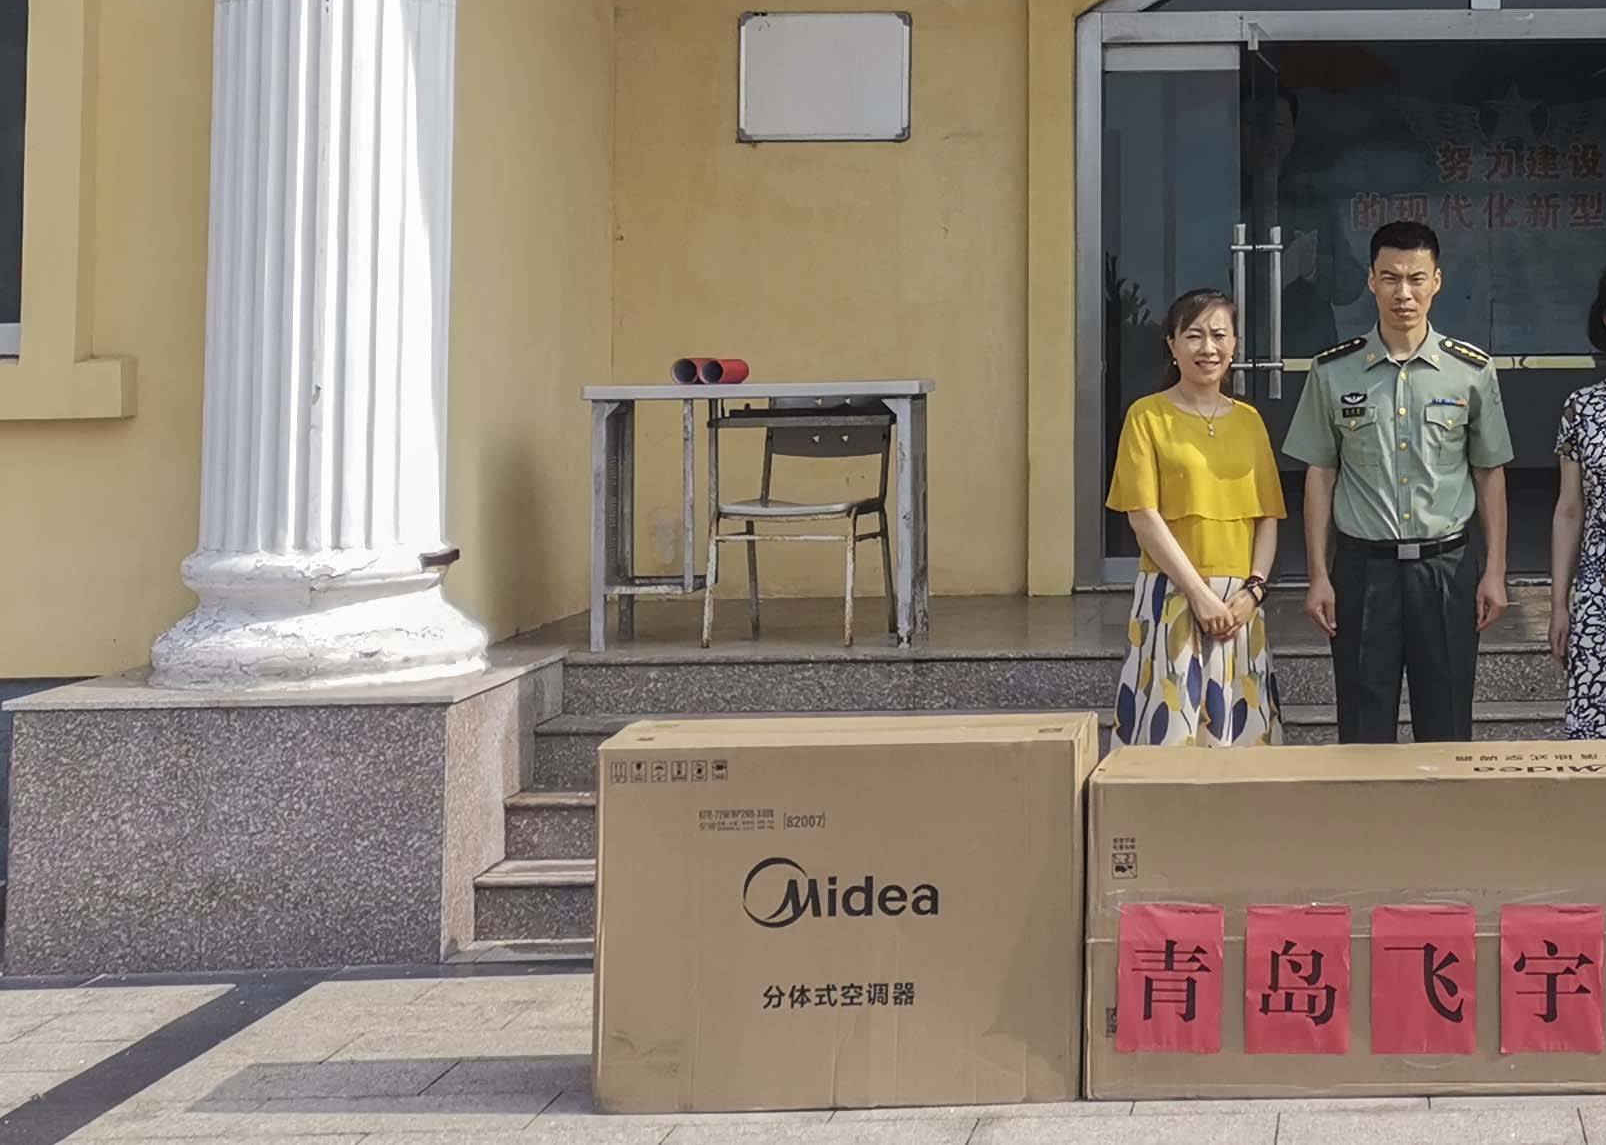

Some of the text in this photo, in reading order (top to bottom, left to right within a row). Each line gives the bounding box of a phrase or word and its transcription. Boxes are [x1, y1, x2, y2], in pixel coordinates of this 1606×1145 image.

[743, 857, 939, 928] Midea
[762, 982, 916, 1009] 分体式空调器
